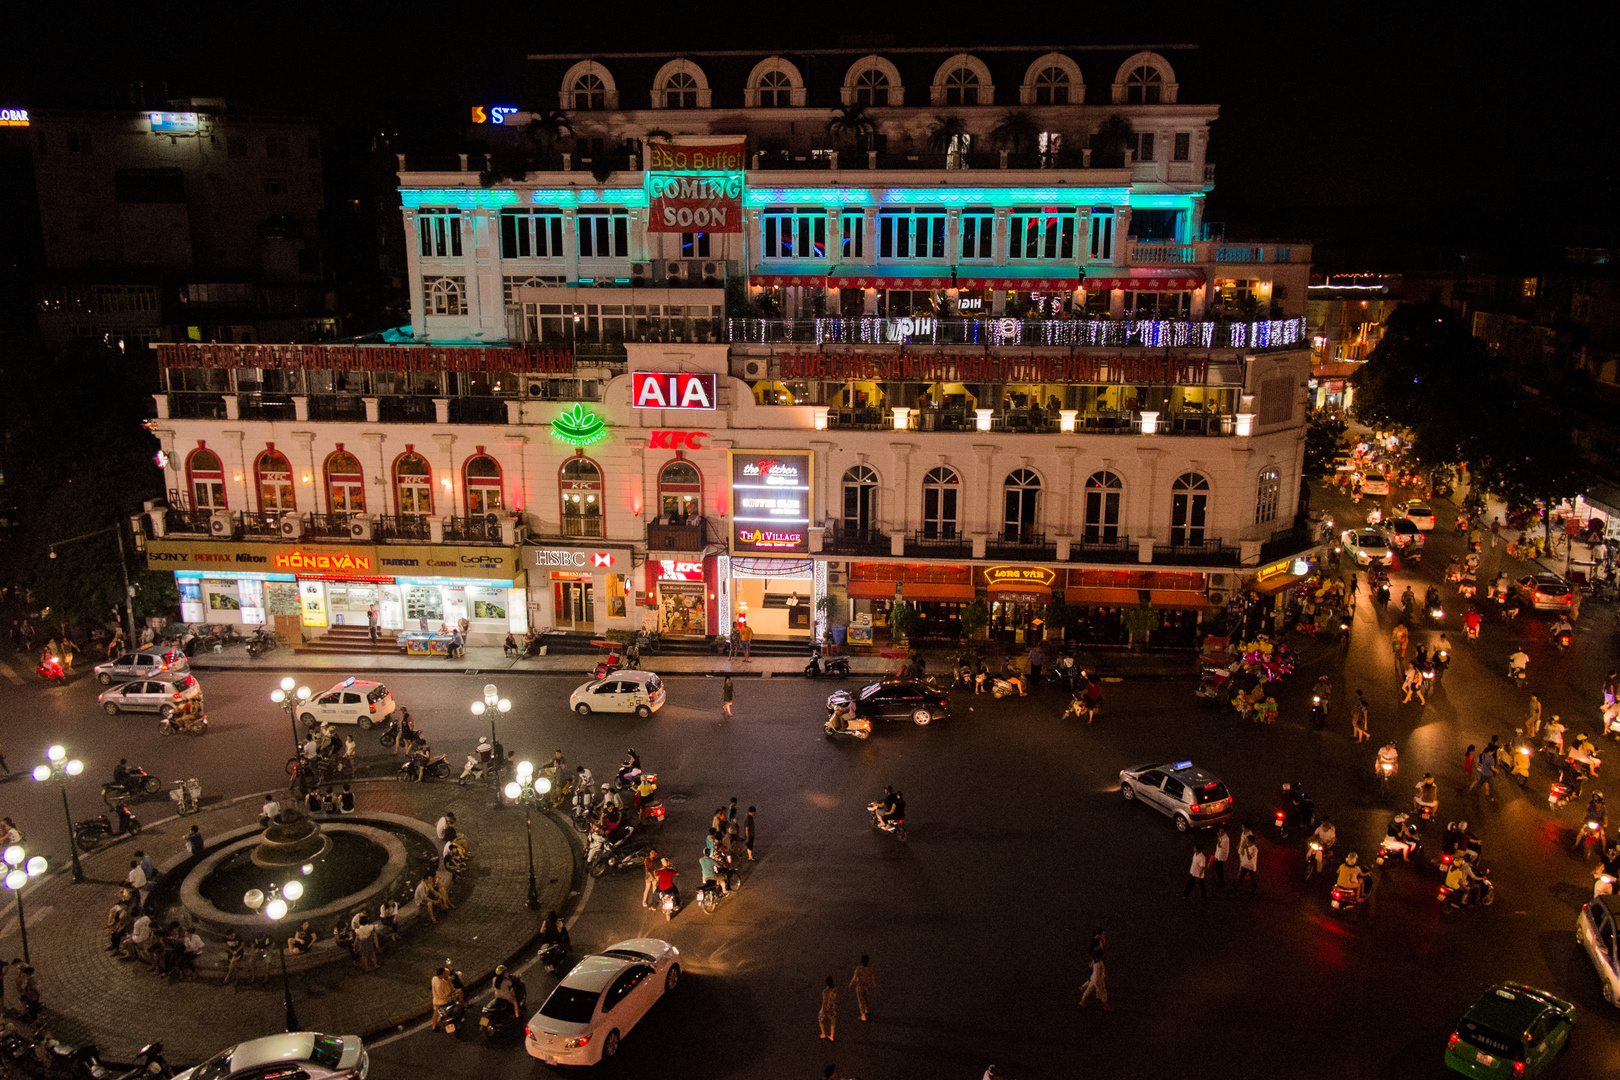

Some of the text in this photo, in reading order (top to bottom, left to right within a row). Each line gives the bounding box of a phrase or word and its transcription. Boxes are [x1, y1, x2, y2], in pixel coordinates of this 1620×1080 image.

[650, 150, 742, 169] BBQ Buffet
[650, 178, 741, 199] COMING
[663, 206, 728, 228] SOON
[636, 375, 711, 407] AIA
[649, 431, 704, 450] KFC
[743, 460, 798, 476] the Kitchen
[149, 553, 189, 561] SONY
[194, 554, 231, 562] PENTAX
[235, 553, 267, 563] Nikon
[330, 554, 369, 569] VÂN
[380, 558, 419, 567] TAMRON
[426, 559, 457, 567] Canon
[461, 555, 503, 564] GoPro
[535, 550, 586, 567] HSBC
[675, 562, 702, 573] KFC
